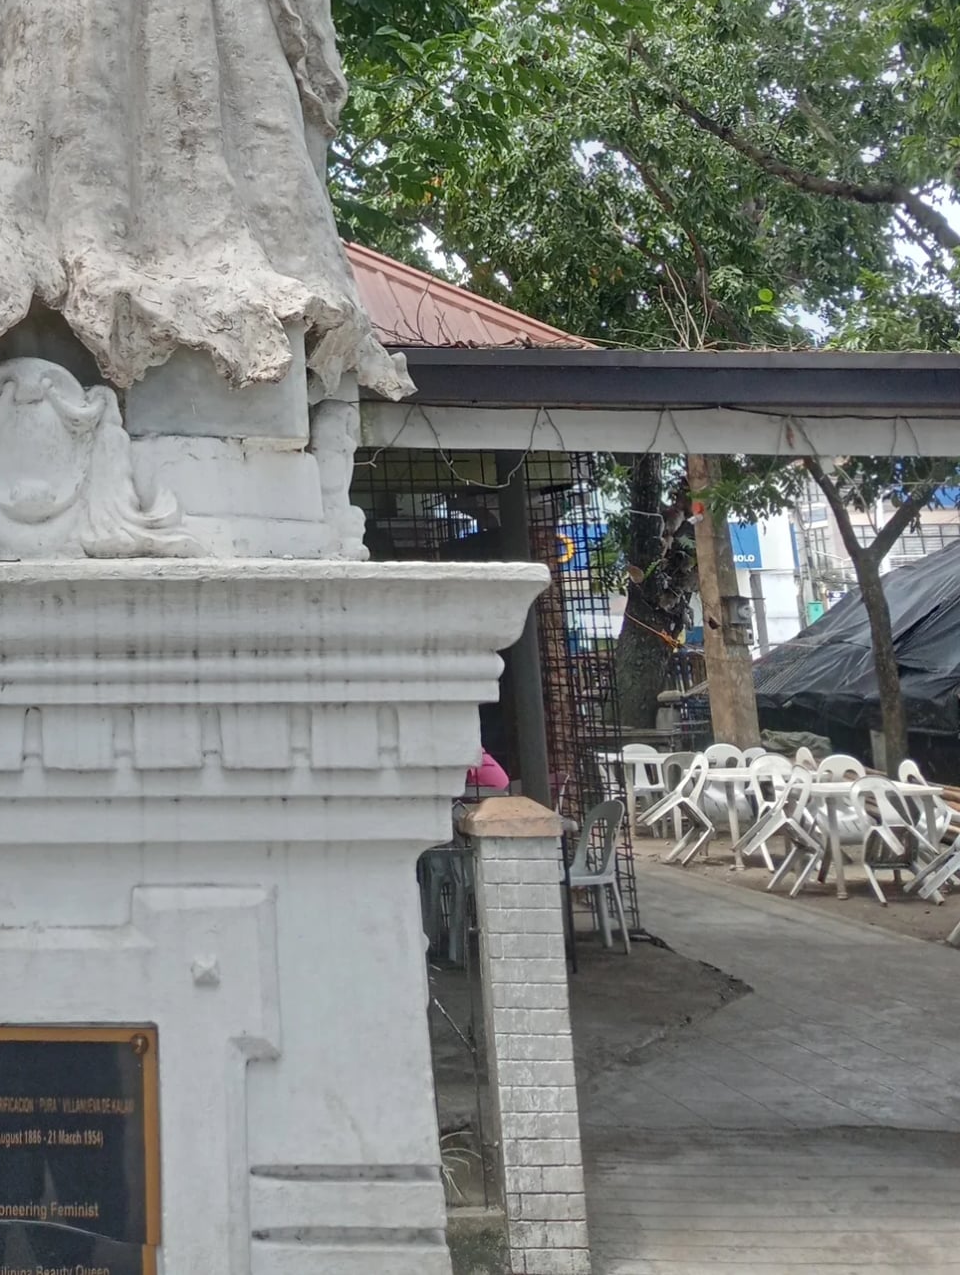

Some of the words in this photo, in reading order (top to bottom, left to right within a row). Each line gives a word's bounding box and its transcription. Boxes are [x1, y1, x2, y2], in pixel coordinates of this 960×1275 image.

[48, 1130, 56, 1144] 21
[59, 1130, 82, 1144] March
[50, 1201, 99, 1217] Feminist
